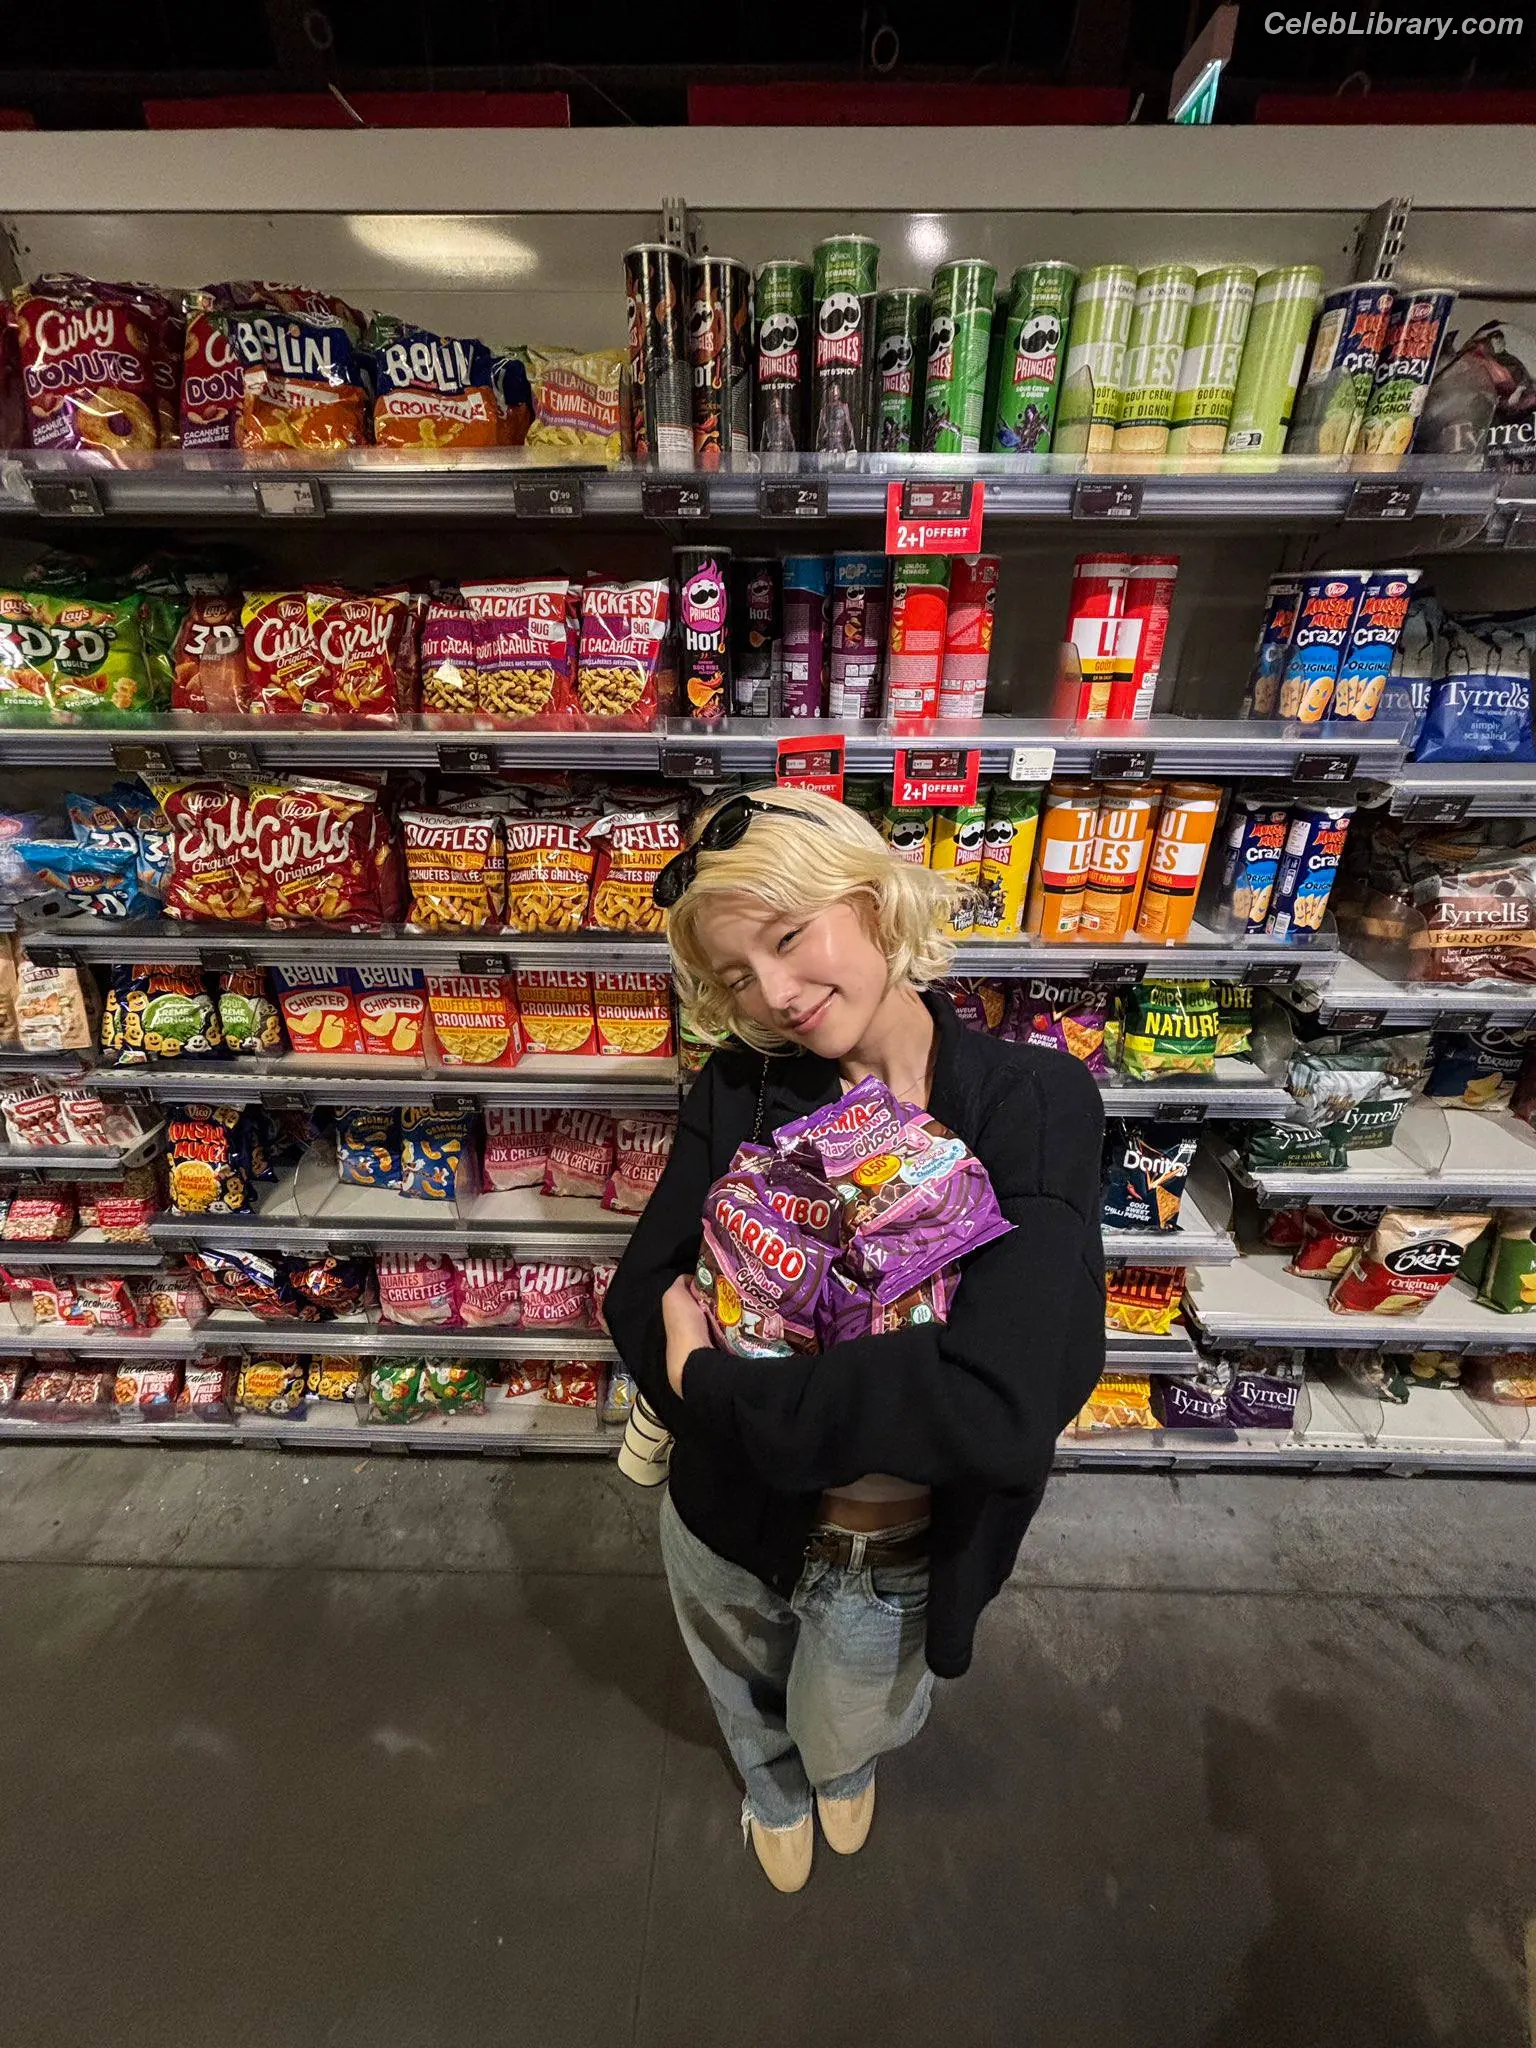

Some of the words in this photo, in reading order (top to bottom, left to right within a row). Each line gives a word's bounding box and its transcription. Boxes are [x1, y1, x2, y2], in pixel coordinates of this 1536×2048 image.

[35, 305, 114, 356] Curly
[818, 337, 860, 368] PRINGLES
[24, 350, 144, 399] DONUTS
[759, 355, 799, 381] PRINGLES
[1015, 355, 1057, 383] PRINGLES
[1376, 358, 1430, 384] Crazy
[1125, 388, 1147, 402] GOÛT
[550, 391, 619, 424] EMMENTAL
[1123, 405, 1135, 419] ET
[1137, 404, 1169, 417] OIGNON
[1194, 403, 1207, 416] ET
[1372, 402, 1411, 416] OIGNON
[897, 525, 926, 548] 2+1
[925, 527, 968, 538] OFFERT
[485, 586, 528, 594] MONOPRIX
[1327, 583, 1347, 595] Vico
[1387, 583, 1406, 595] Vico
[280, 605, 303, 618] Vico
[470, 594, 552, 618] RACKETS
[583, 591, 653, 616] ACKETS
[60, 608, 91, 623] Lay's
[344, 608, 367, 620] Vico
[689, 605, 721, 623] PRINGLES
[686, 630, 721, 651] HOT
[1296, 627, 1347, 647] Crazy
[1353, 627, 1401, 647] Crazy
[1470, 721, 1501, 733] simply
[902, 782, 929, 801] 2+1
[928, 784, 967, 793] OFFERT
[283, 801, 314, 818] Vico
[1160, 811, 1188, 841] UI
[255, 810, 354, 874] Curly
[274, 857, 326, 885] Original
[1435, 932, 1524, 945] FURROWS
[1029, 979, 1108, 1008] Doritos
[287, 995, 347, 1013] CHIPSTER
[362, 997, 422, 1014] CHIPSTER
[520, 1002, 591, 1018] CROQUANTS
[598, 1005, 668, 1020] CROQUANTS
[434, 1011, 506, 1030] CROQUANTS
[1145, 1009, 1220, 1038] NATURE
[1028, 1037, 1058, 1050] PAPRIKA
[1030, 1031, 1058, 1044] SAVEUR
[854, 1119, 901, 1158] Choco
[771, 1190, 832, 1230] RIBO
[1104, 1205, 1125, 1218] CHILLI
[1123, 1210, 1152, 1223] PEPPER
[1124, 1206, 1151, 1218] SWEET
[1129, 1201, 1151, 1211] GOÛT
[715, 1198, 807, 1282] HARIBO
[381, 1252, 445, 1275] HIPS
[387, 1281, 448, 1301] CREVETTES
[735, 1267, 781, 1311] Choco
[1237, 1380, 1299, 1408] Tyrrell
